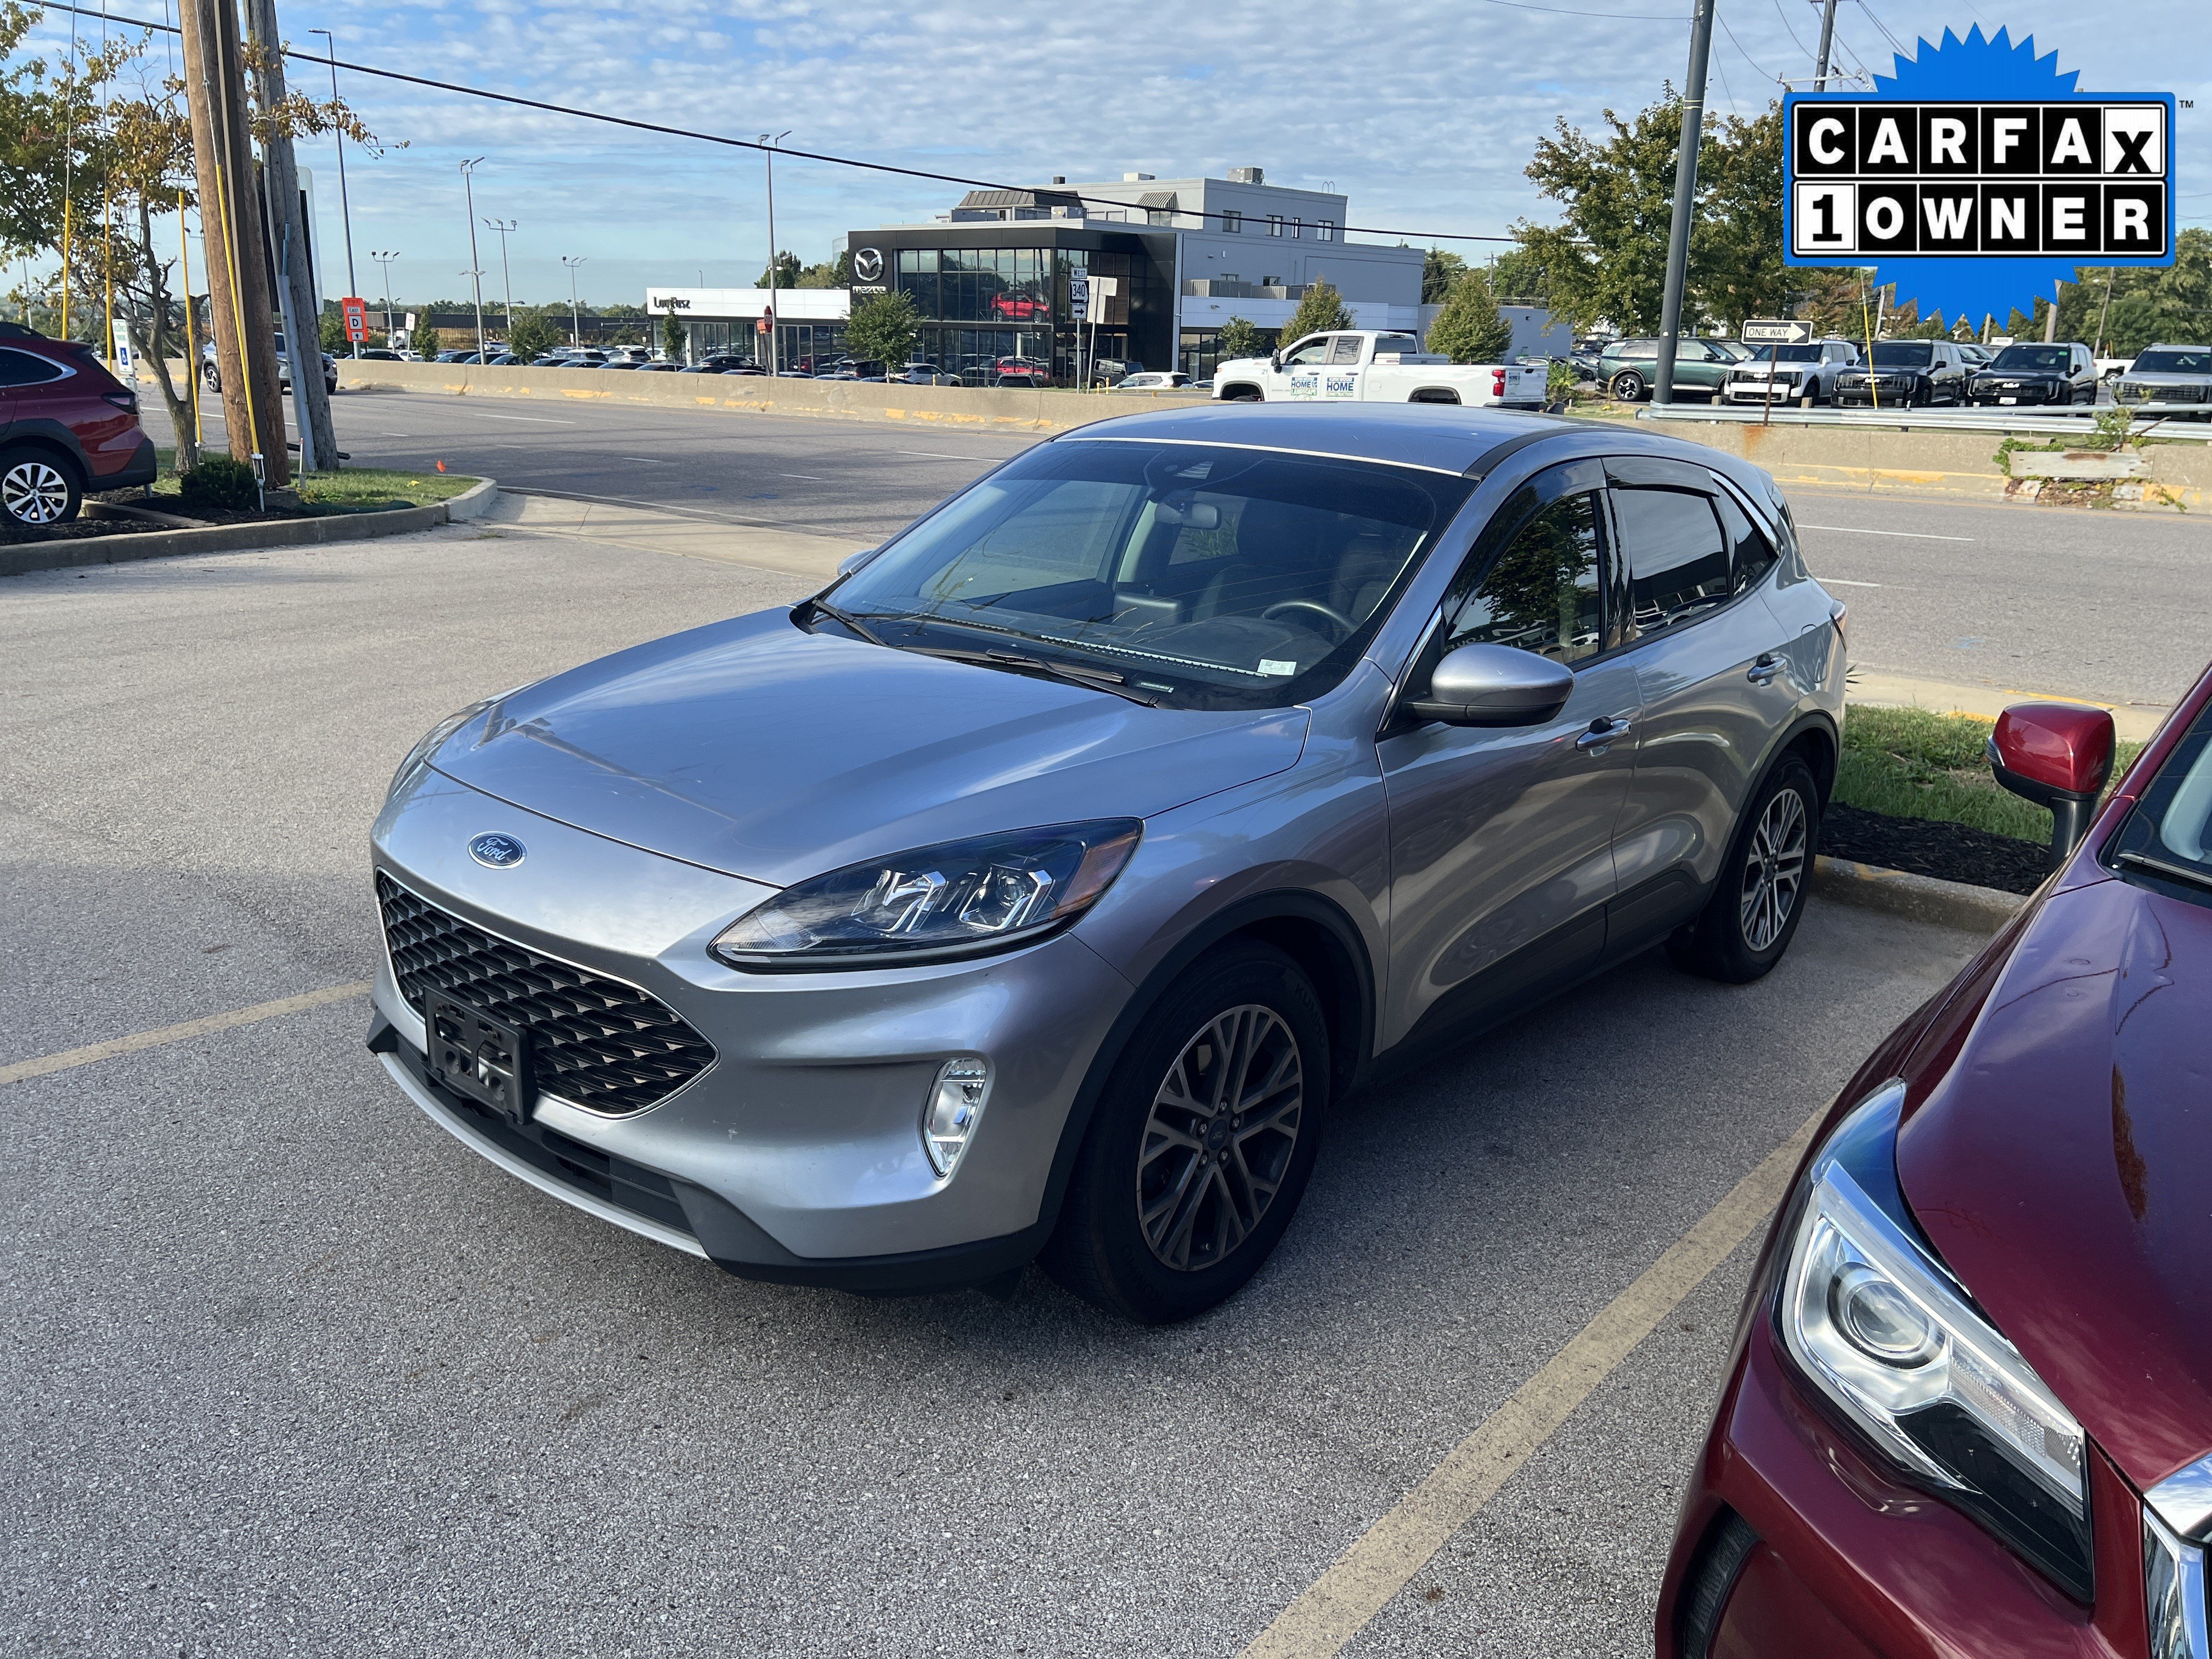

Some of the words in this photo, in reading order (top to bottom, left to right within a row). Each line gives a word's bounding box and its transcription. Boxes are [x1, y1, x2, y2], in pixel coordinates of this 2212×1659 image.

[1073, 269, 1086, 277] WEST
[1073, 284, 1086, 297] 340
[352, 318, 359, 327] D
[1748, 328, 1767, 336] ONE
[1770, 328, 1788, 337] WAY
[1327, 382, 1354, 391] HOME
[477, 837, 512, 861] Ford
